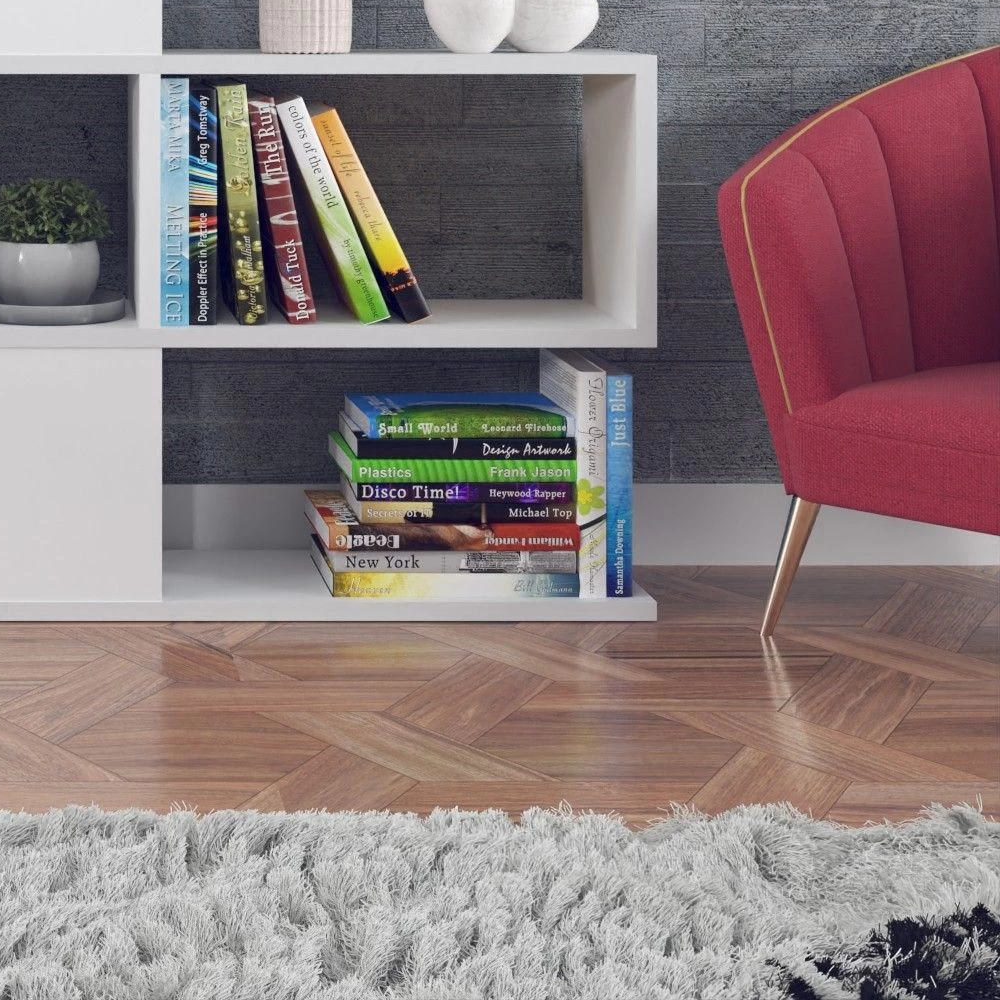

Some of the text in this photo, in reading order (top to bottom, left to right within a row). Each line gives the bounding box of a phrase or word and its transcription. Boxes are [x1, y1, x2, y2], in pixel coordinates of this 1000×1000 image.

[168, 82, 183, 173] MARTA MIKA
[197, 95, 210, 165] Greg Tomstway
[258, 104, 283, 177] The Run
[288, 105, 339, 209] colors of the world
[166, 204, 184, 322] MELTING ICE
[197, 212, 210, 322] Doppler Effect in Practice
[286, 238, 310, 320] Donald Tuck
[610, 379, 630, 447] Just Blue
[378, 422, 458, 436] Small World
[481, 423, 566, 433] Leonard Firehose
[482, 442, 572, 459] Design Artwork
[359, 467, 412, 478] Plastics
[490, 466, 571, 477] Frank Jason
[362, 485, 460, 499] Disco Time!
[489, 488, 566, 499] Heywood Rapper
[366, 508, 404, 518] Secrets
[508, 507, 572, 519] Michael Top
[335, 534, 400, 549] Beagle
[528, 537, 574, 546] William
[346, 554, 420, 568] New York
[614, 518, 626, 594] Samantha Downing
